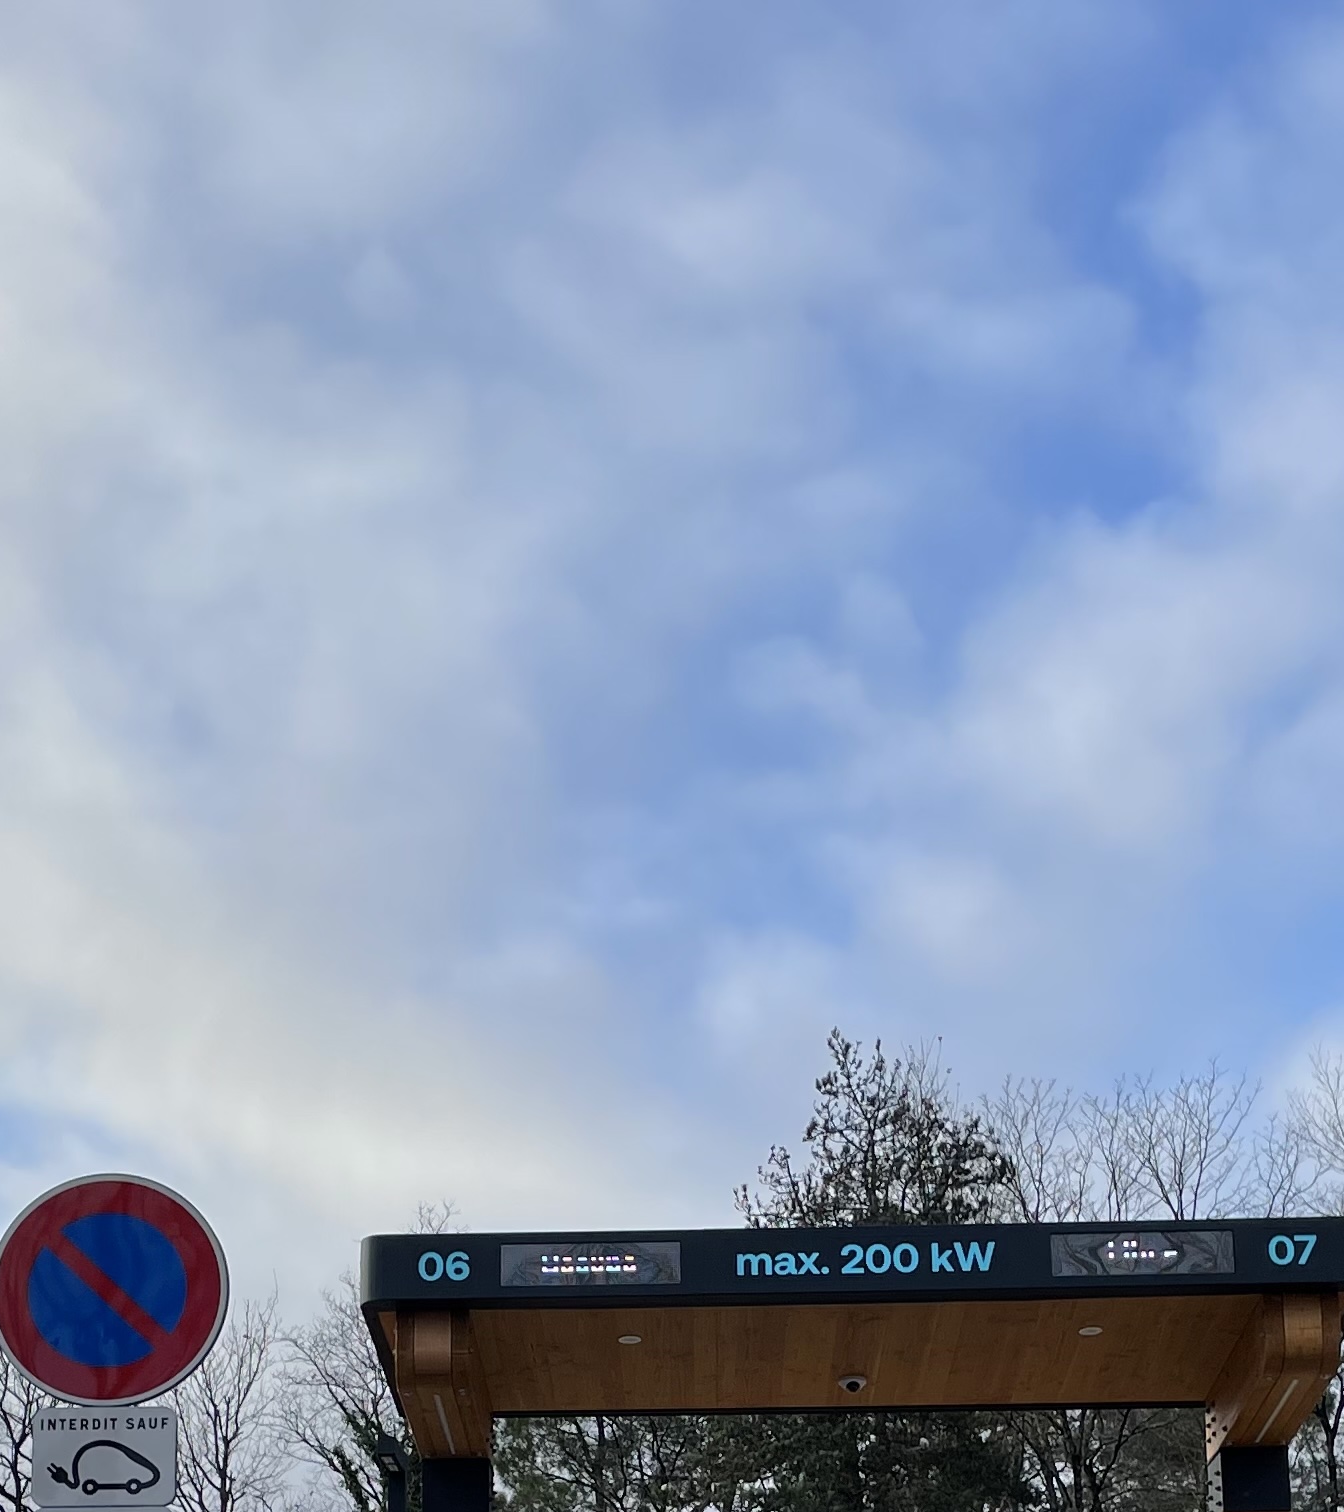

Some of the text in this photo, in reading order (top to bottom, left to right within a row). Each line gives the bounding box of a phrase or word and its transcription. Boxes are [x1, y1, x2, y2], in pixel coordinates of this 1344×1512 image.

[736, 1241, 995, 1276] max. 200 kW
[1268, 1234, 1317, 1266] 07
[418, 1251, 470, 1282] 06
[40, 1417, 169, 1431] INTERDIT SAUF
